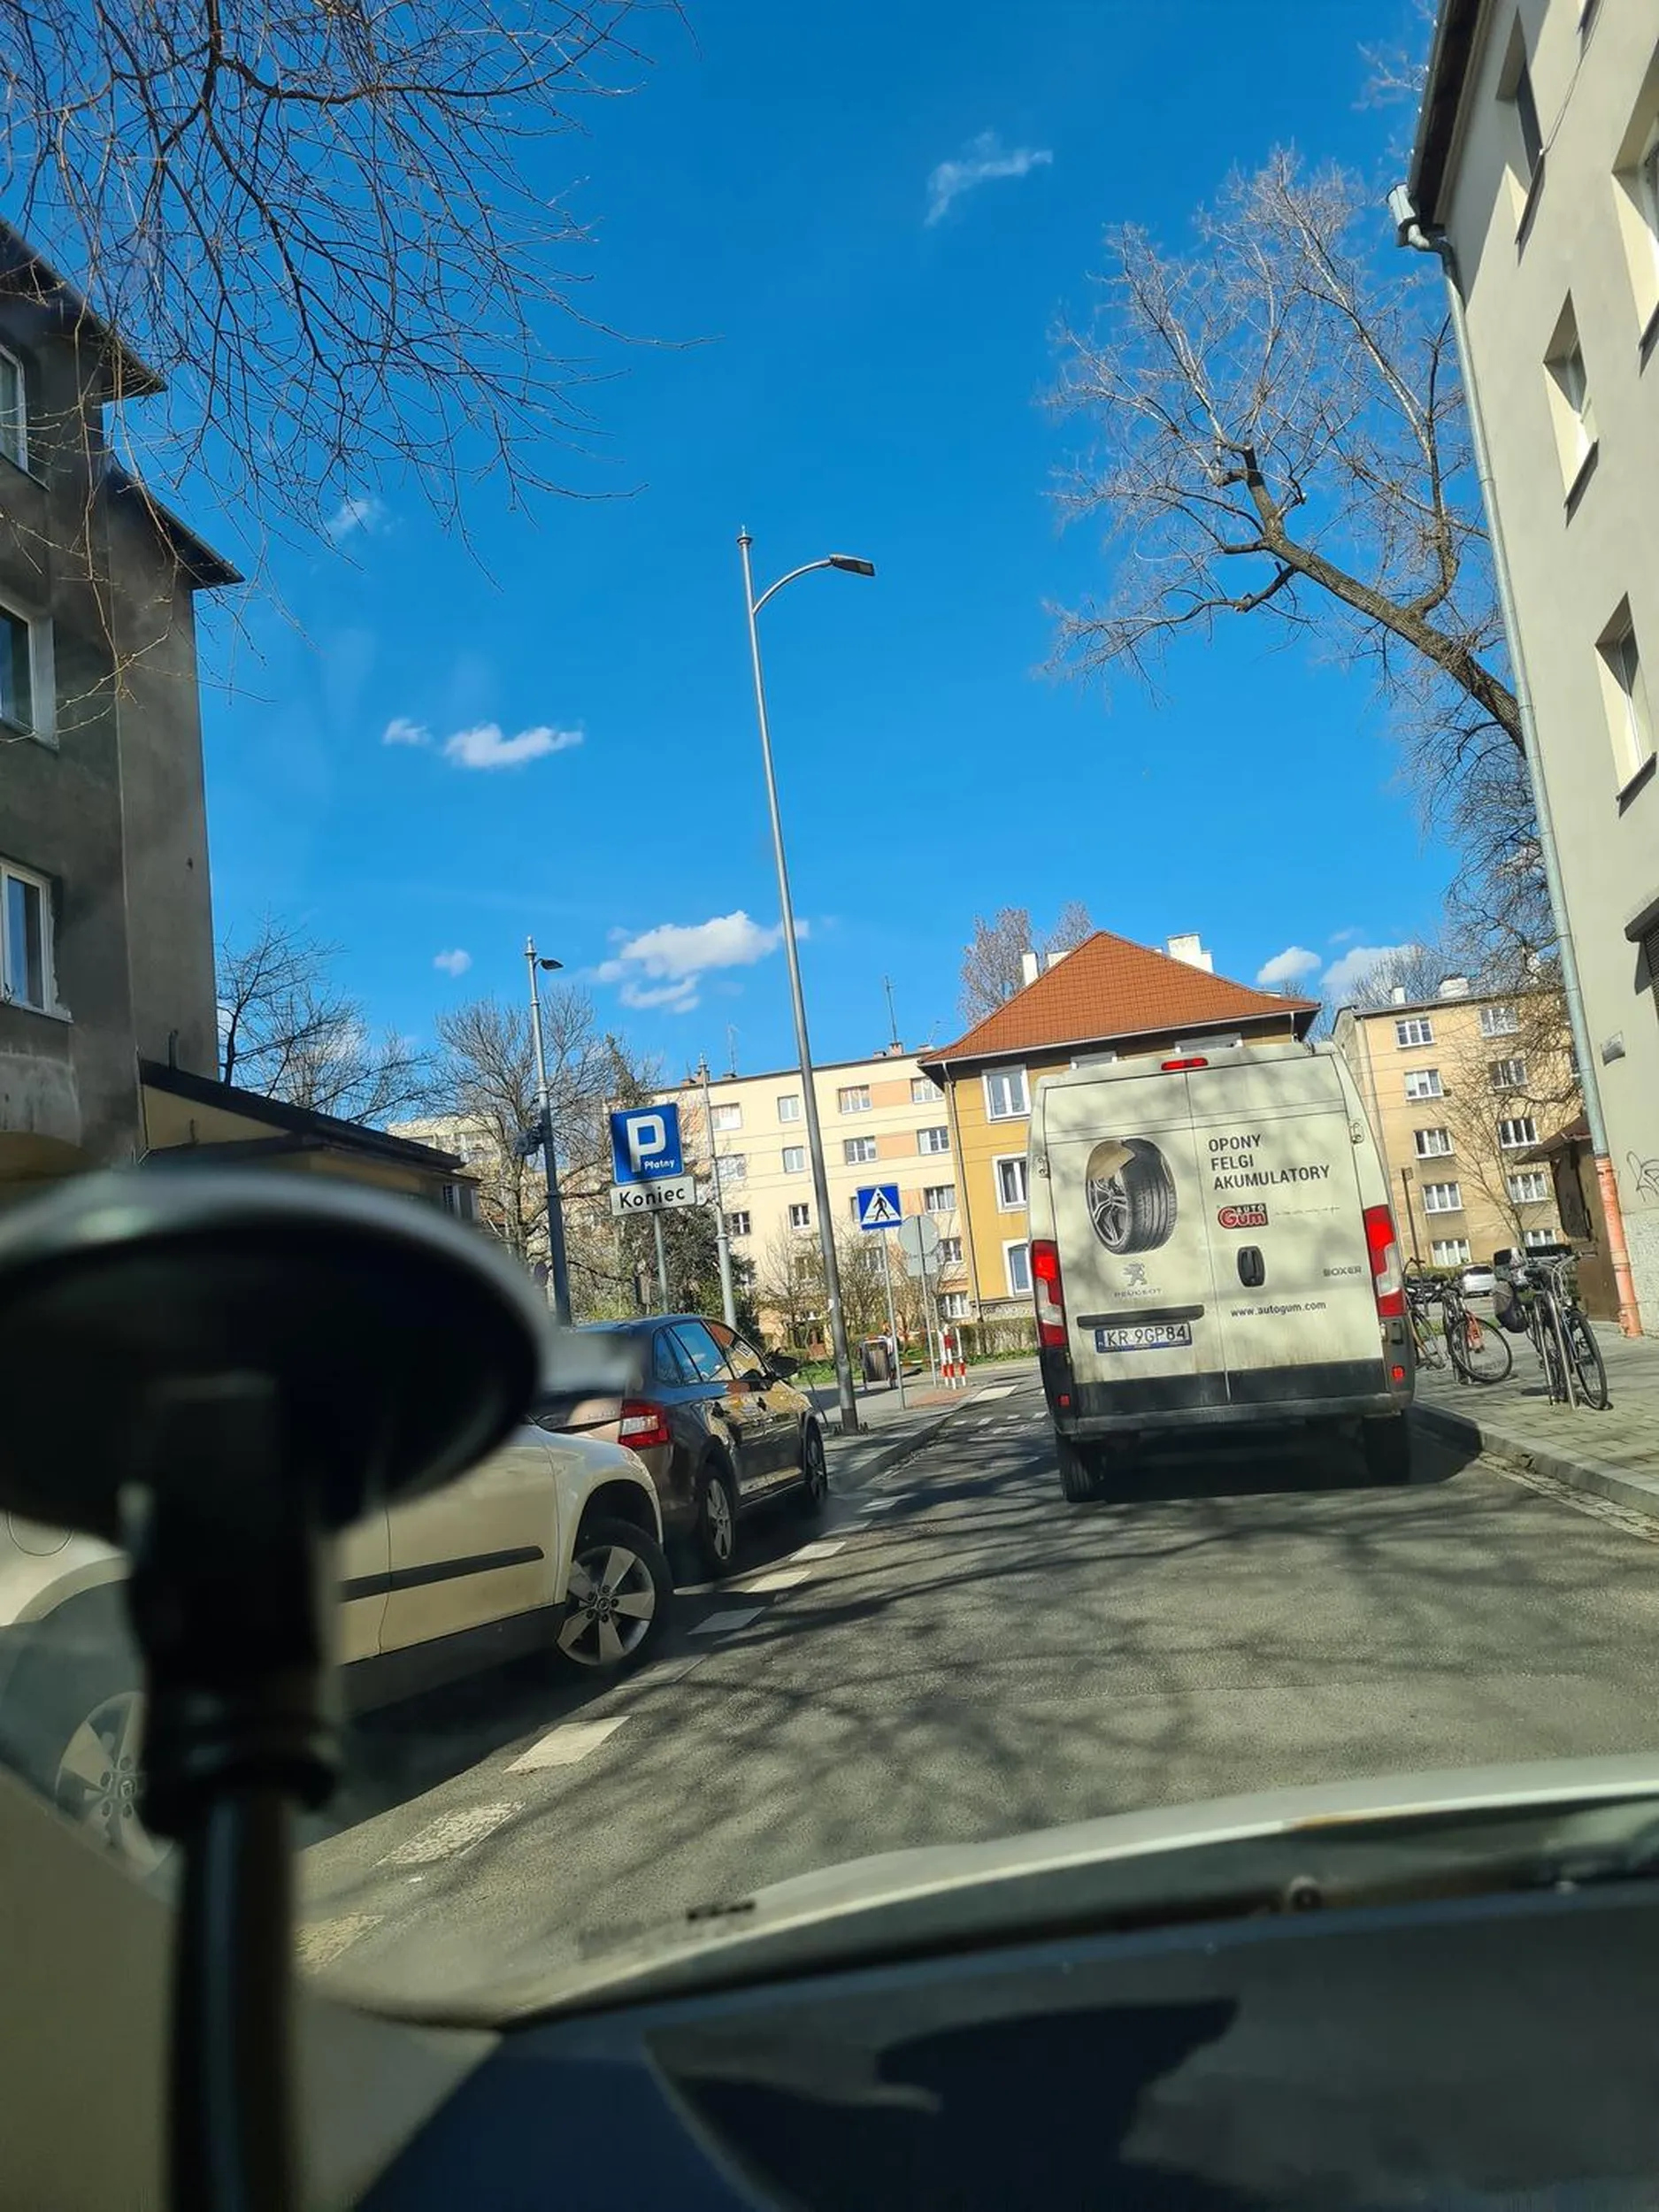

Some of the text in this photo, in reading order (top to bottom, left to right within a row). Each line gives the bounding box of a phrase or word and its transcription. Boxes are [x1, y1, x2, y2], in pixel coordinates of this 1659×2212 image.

[626, 1114, 665, 1173] P
[1209, 1134, 1261, 1152] OPONY
[1211, 1155, 1254, 1171] FELGI
[1214, 1165, 1330, 1190] AKUMULATORY
[619, 1187, 685, 1209] Koniec
[1217, 1206, 1267, 1228] Gum
[1236, 1204, 1265, 1214] AUTO
[1323, 1266, 1363, 1277] BOXER
[1230, 1302, 1326, 1317] www.autogum.com
[1107, 1330, 1129, 1347] KR
[1134, 1325, 1187, 1343] 9GP84
